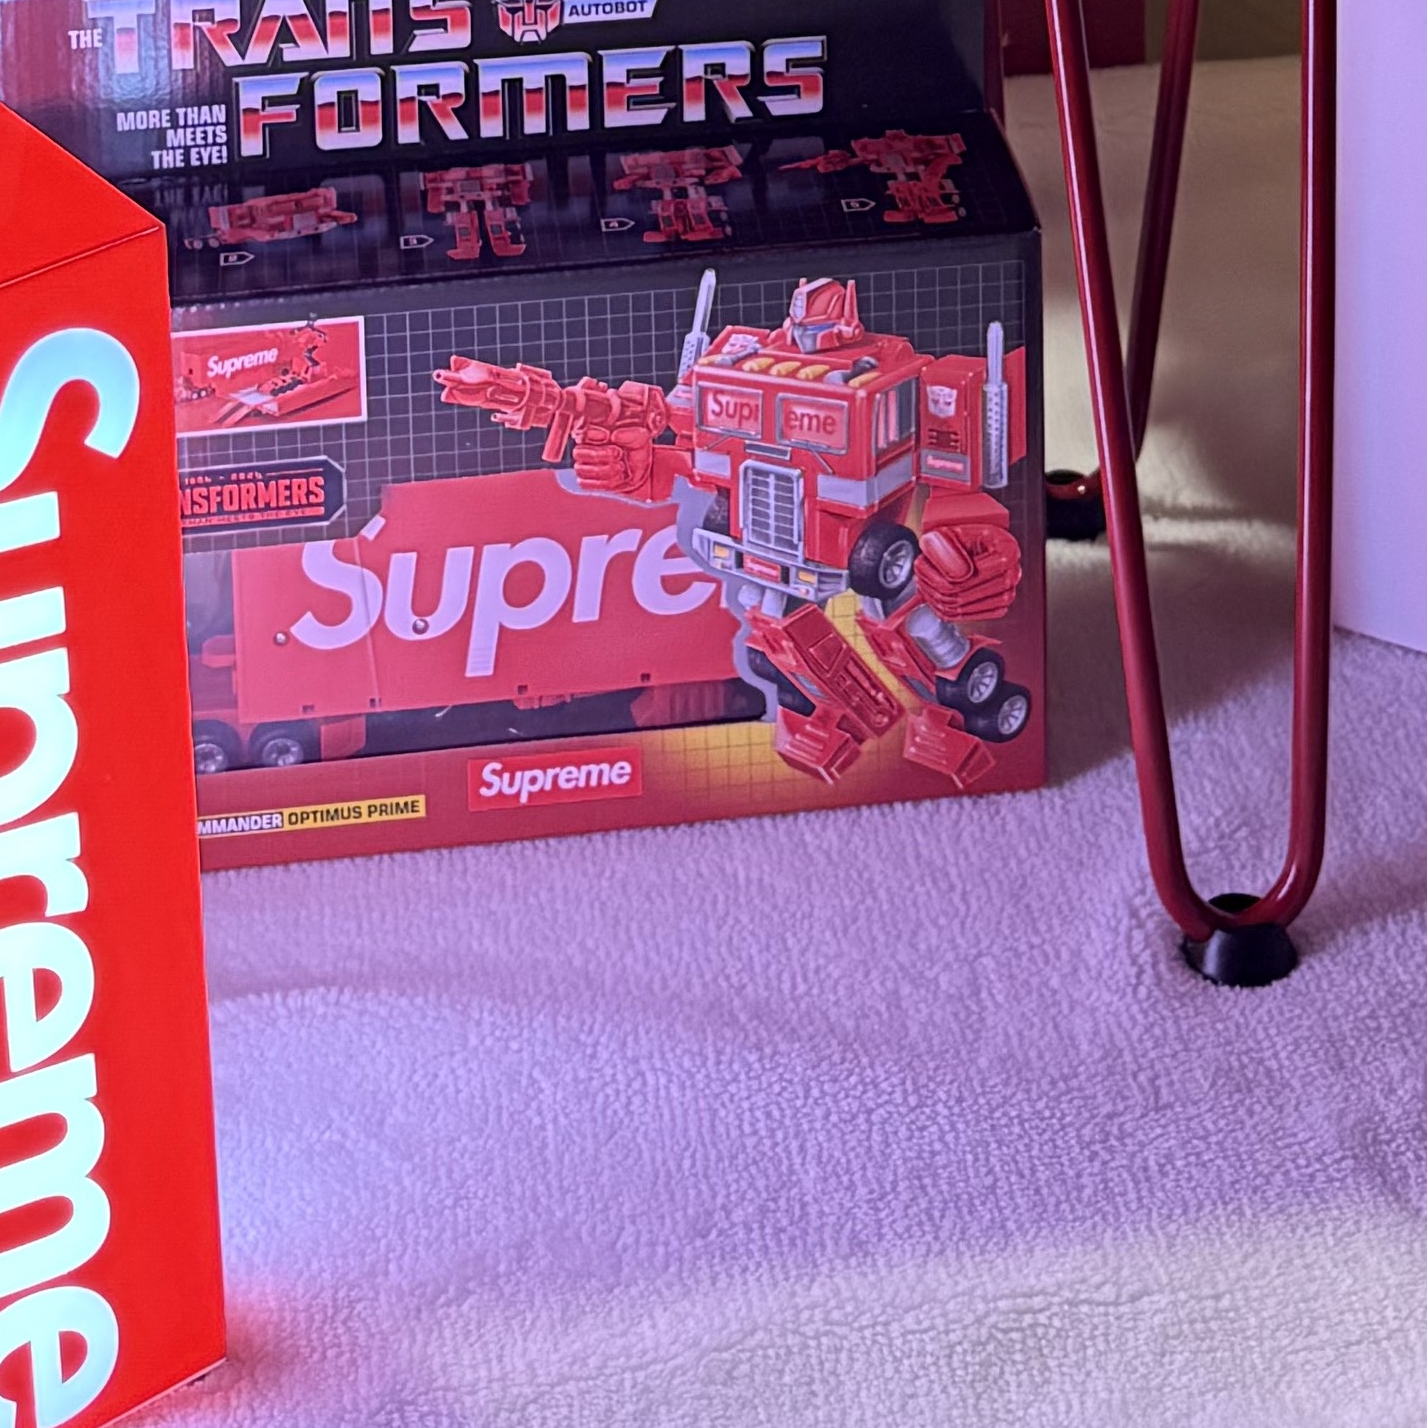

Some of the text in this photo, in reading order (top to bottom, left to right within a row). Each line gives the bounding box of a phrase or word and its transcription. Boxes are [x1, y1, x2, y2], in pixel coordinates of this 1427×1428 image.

[568, 0, 648, 18] AUTOBOT
[68, 28, 103, 50] THE
[232, 35, 827, 158] FORMERS
[117, 104, 226, 132] MORE THAN
[166, 125, 227, 147] MEETS
[151, 145, 228, 170] THE EYE!
[207, 348, 278, 378] Supreme
[479, 761, 632, 804] Supreme
[288, 806, 363, 826] OPTIMUS
[368, 799, 421, 820] PRIME
